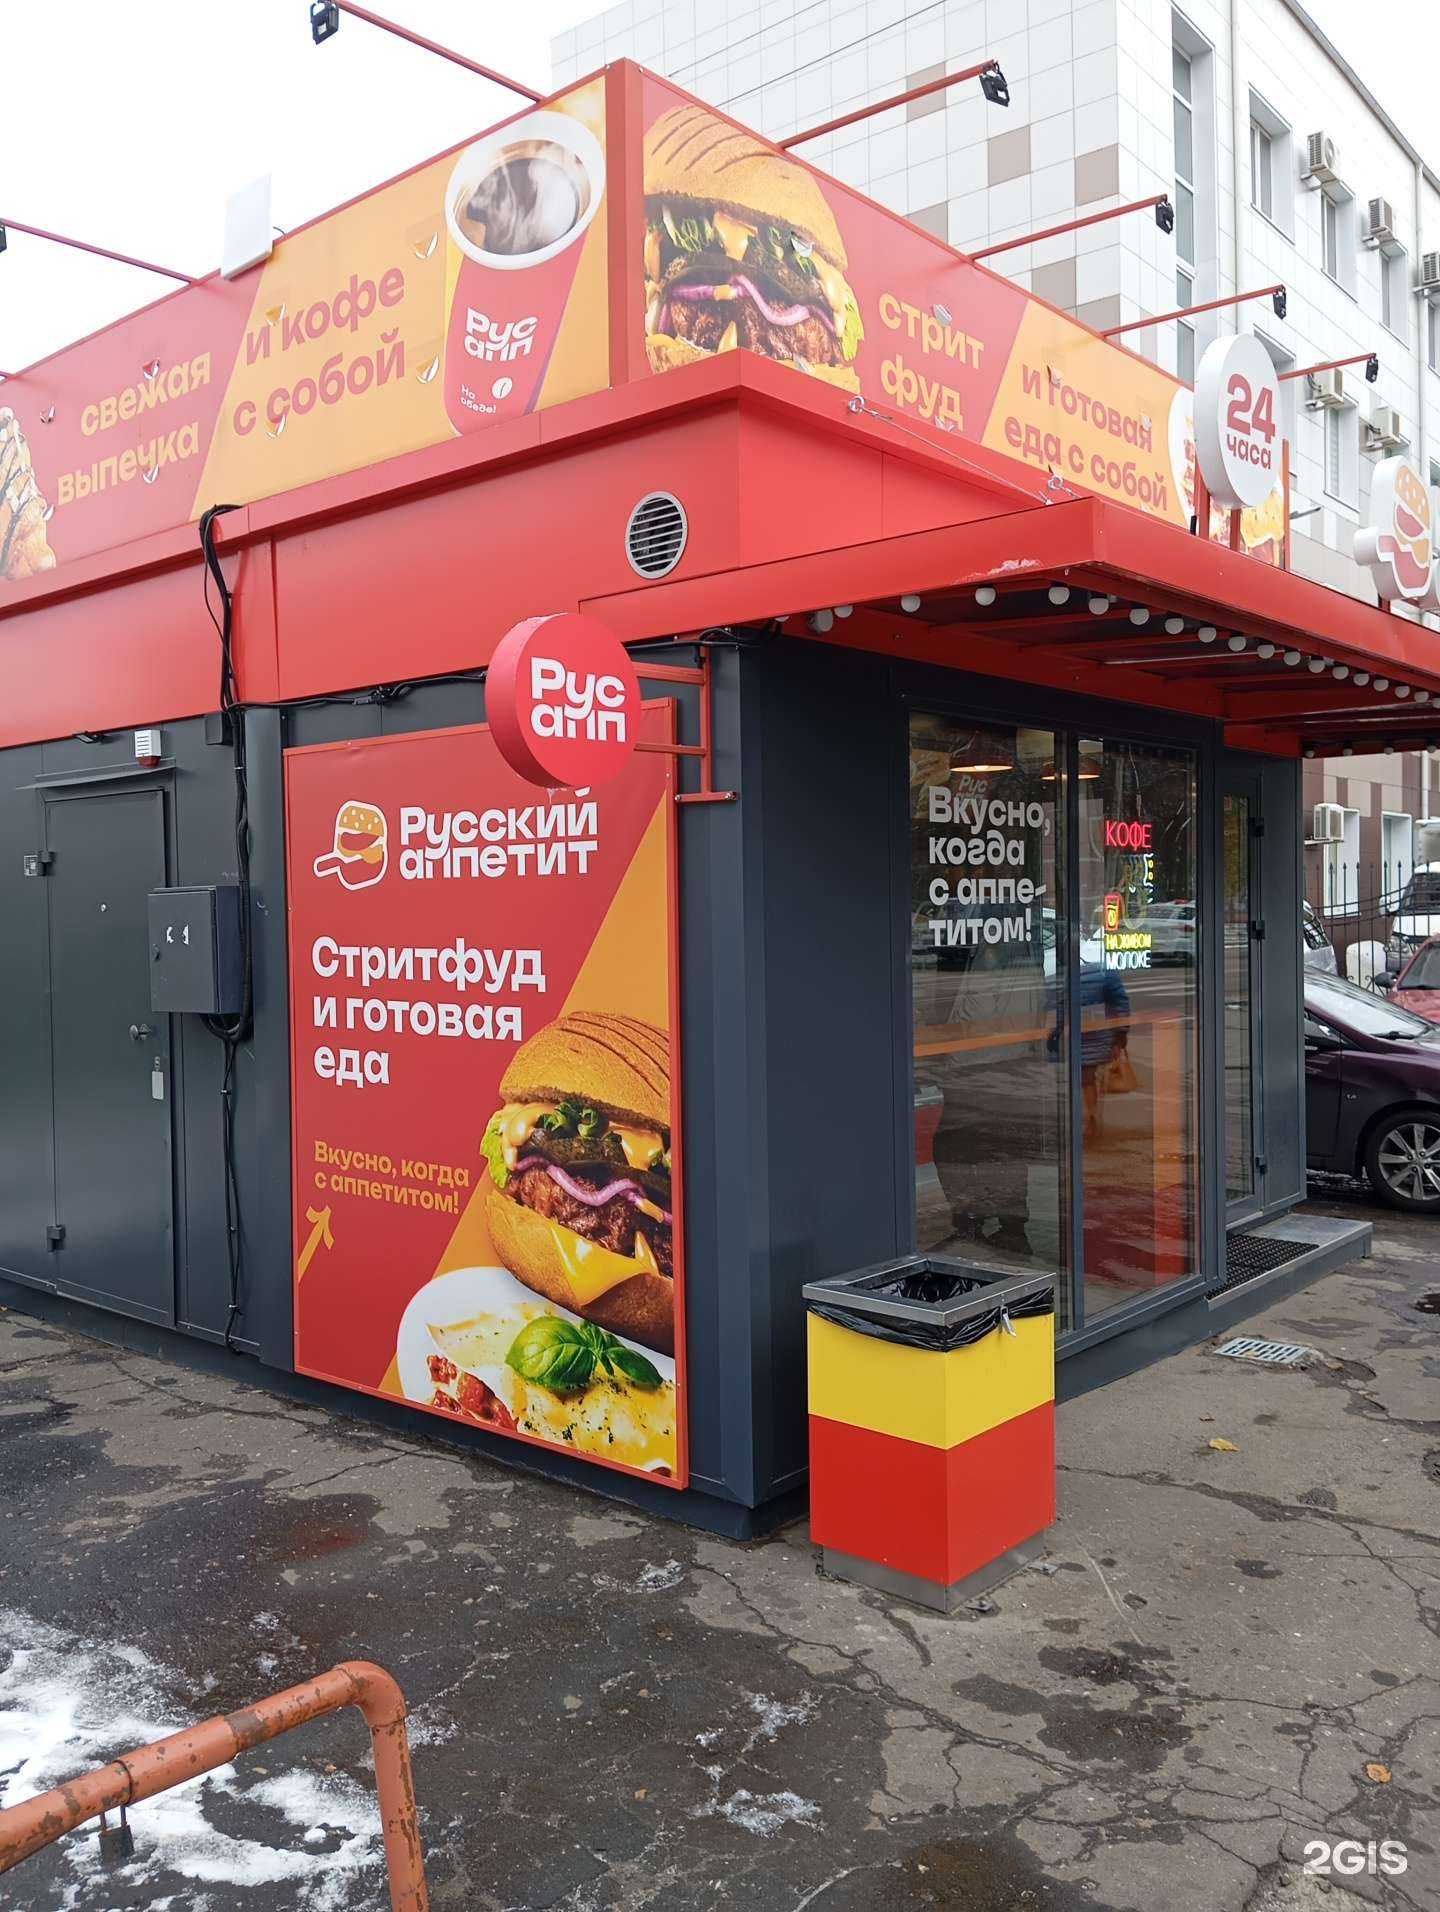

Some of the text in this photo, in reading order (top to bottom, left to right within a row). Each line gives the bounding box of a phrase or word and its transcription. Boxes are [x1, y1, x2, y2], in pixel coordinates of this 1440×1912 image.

[247, 268, 405, 366] и кофе
[466, 307, 539, 351] Рус
[879, 293, 985, 370] стрит
[81, 352, 211, 437] свежая
[233, 327, 405, 437] с собой
[880, 354, 964, 432] фуд
[1022, 364, 1153, 453] и готовая
[1226, 373, 1276, 443] 24
[58, 422, 199, 506] выпечка
[1004, 416, 1168, 512] еда с собой
[1226, 433, 1272, 470] часа
[530, 656, 626, 719] Рус
[400, 787, 599, 860] Русский
[929, 785, 1051, 836] Вкусно,
[1105, 820, 1152, 850] КОФЕ
[400, 839, 599, 880] аппетит
[929, 829, 1025, 866] когда
[929, 878, 1047, 906] с аппе-
[929, 908, 1032, 947] титом!
[312, 936, 546, 993] Стритфуд
[1106, 950, 1152, 970] МОЛОКЕ
[313, 996, 523, 1041] и готовая
[314, 1046, 390, 1088] еда
[314, 1140, 470, 1188] Вкусно, когда
[314, 1171, 460, 1215] с аппетитом!
